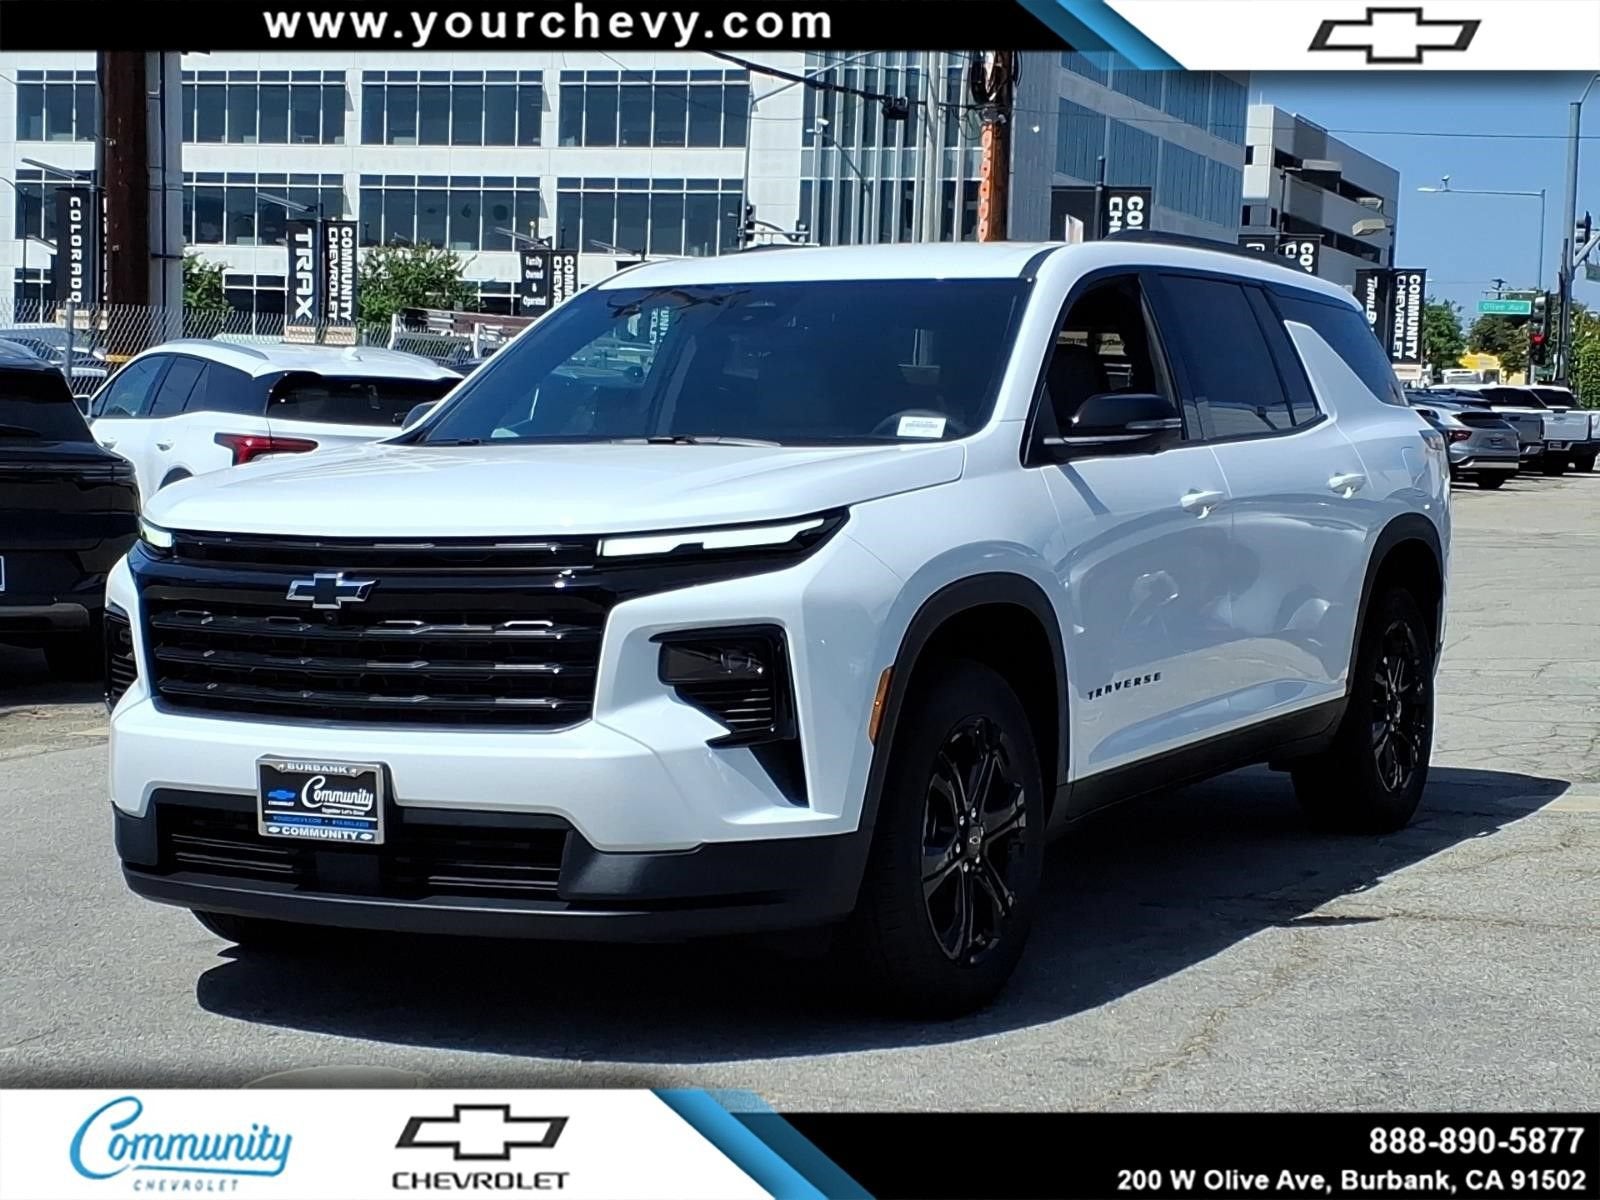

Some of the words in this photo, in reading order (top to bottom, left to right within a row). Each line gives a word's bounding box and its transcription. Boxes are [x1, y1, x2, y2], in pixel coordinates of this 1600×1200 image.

[1126, 196, 1144, 230] CO
[70, 196, 82, 303] COLORADO
[295, 227, 313, 320] TRAX
[328, 227, 339, 321] CHEVROLET
[341, 226, 353, 321] COMMUNITY
[1366, 276, 1378, 332] TRAILB
[1393, 275, 1407, 360] CHEVROLET
[1405, 274, 1421, 359] COMMUNITY
[1087, 672, 1161, 700] TRAVERSE
[287, 762, 348, 774] BURBANK
[301, 775, 374, 811] Community
[281, 826, 359, 840] COMMUNITY
